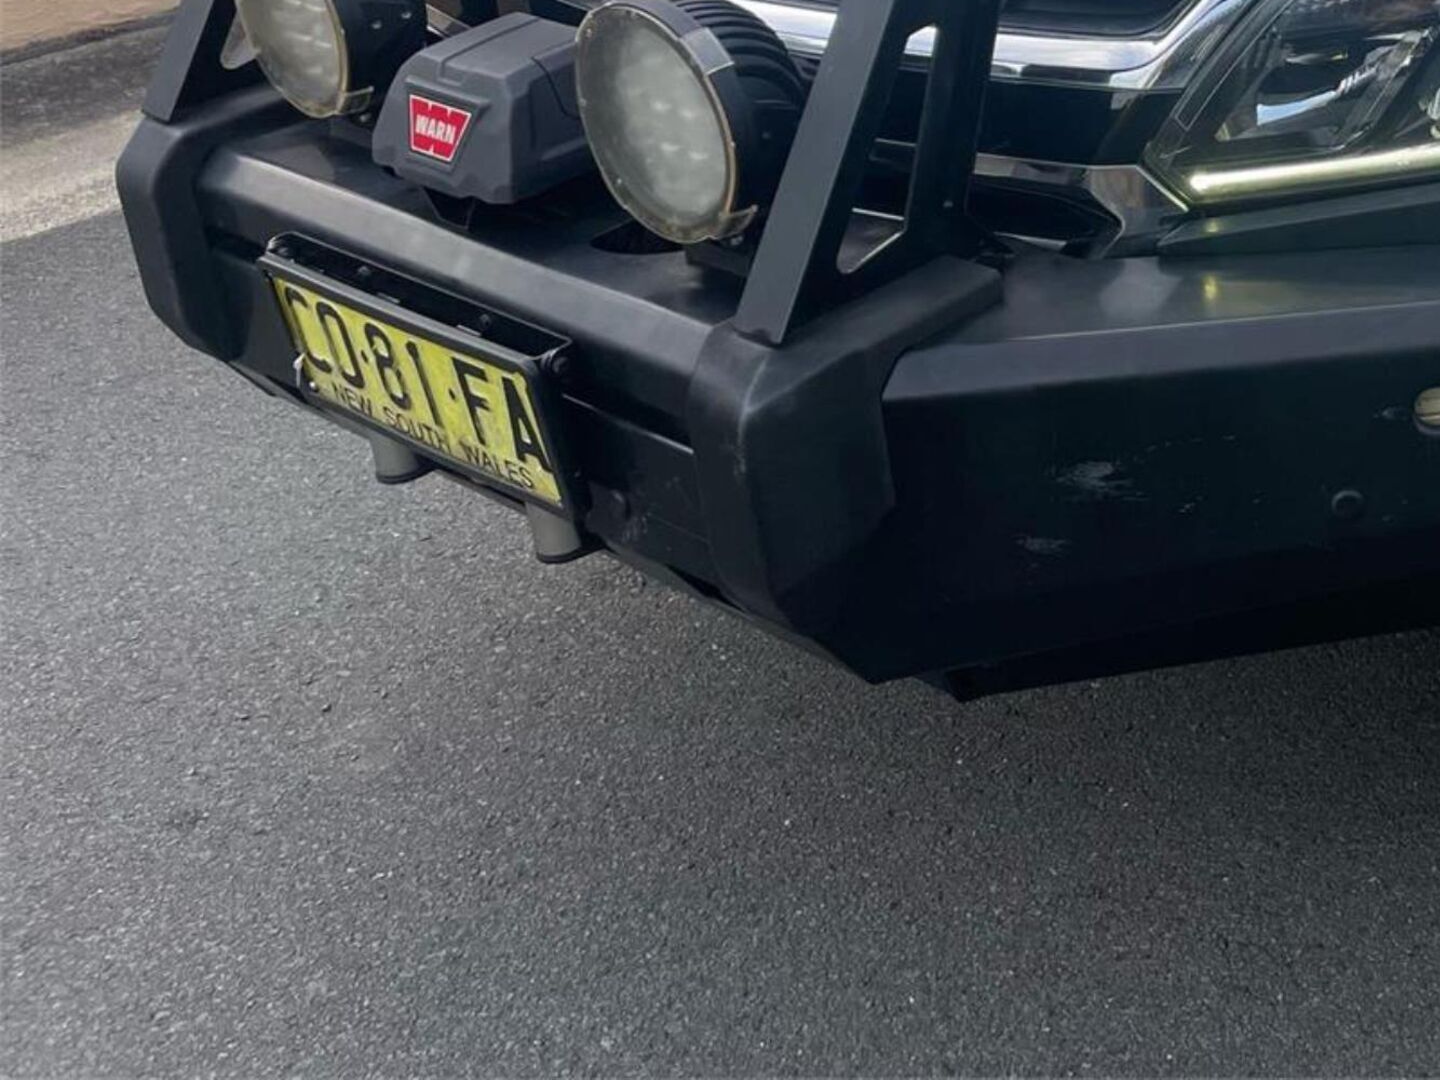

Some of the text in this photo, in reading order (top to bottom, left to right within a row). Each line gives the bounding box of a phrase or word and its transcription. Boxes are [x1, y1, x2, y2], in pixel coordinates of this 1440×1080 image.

[414, 113, 457, 145] WARN
[331, 381, 534, 490] NEW SOUTH WALES
